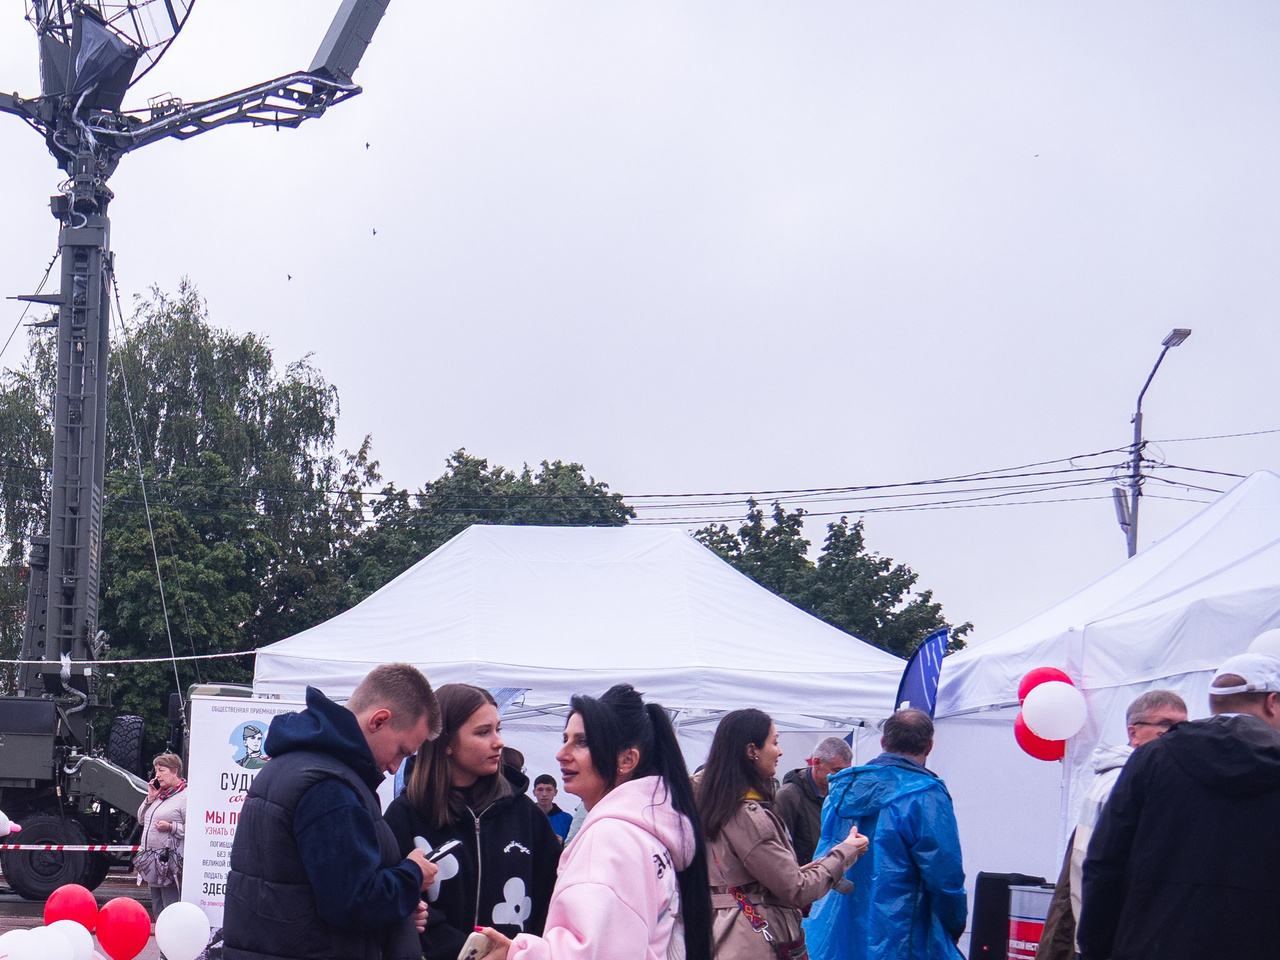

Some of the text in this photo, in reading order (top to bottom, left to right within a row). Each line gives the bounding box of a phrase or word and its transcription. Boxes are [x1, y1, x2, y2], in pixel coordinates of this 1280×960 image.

[205, 810, 225, 824] МЫ
[204, 826, 228, 836] УЗНАТЬ
[216, 850, 227, 858] БЕЗ
[202, 859, 226, 868] ВЕЛИКОЙ
[203, 871, 223, 880] ПОДАТЬ
[202, 882, 227, 897] ЗДЕС
